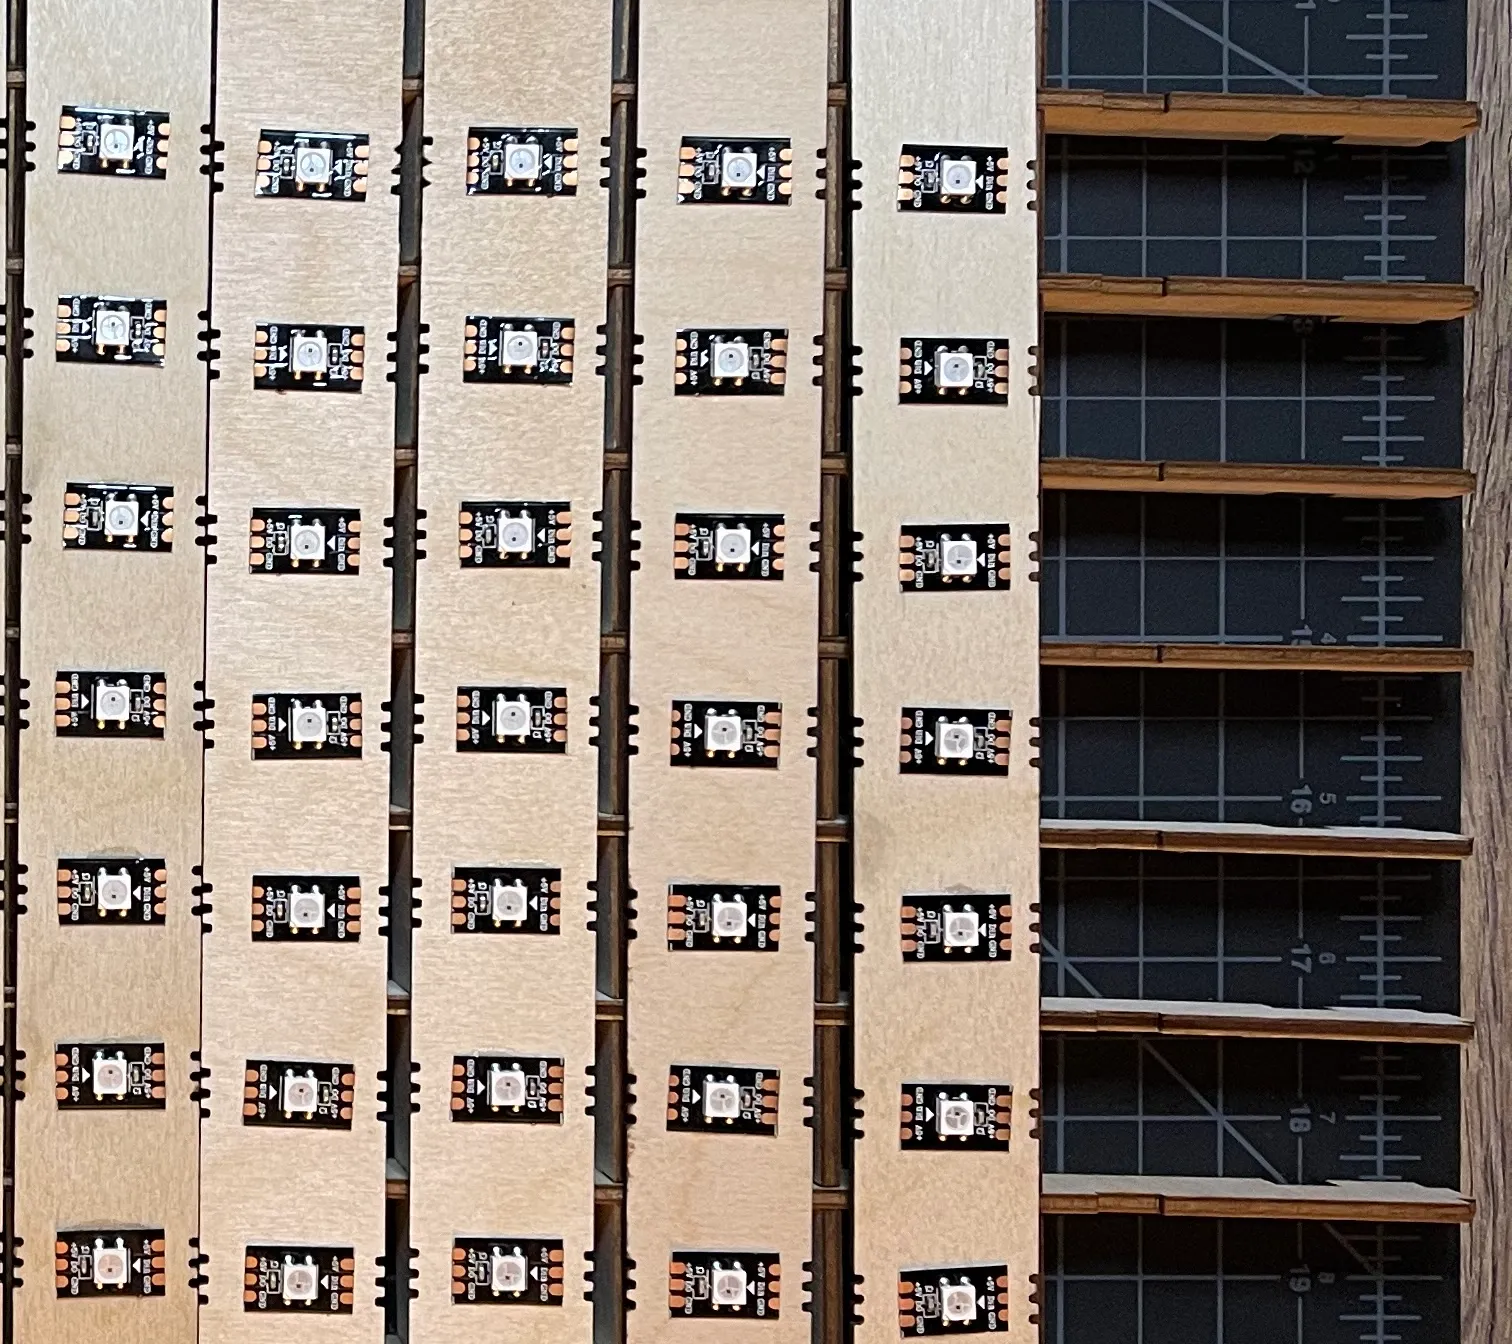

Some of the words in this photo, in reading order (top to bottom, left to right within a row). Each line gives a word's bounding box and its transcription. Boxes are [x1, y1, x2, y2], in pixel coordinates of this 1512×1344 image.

[1291, 785, 1312, 813] 16
[1291, 944, 1312, 973] 17
[1290, 1104, 1311, 1132] 18
